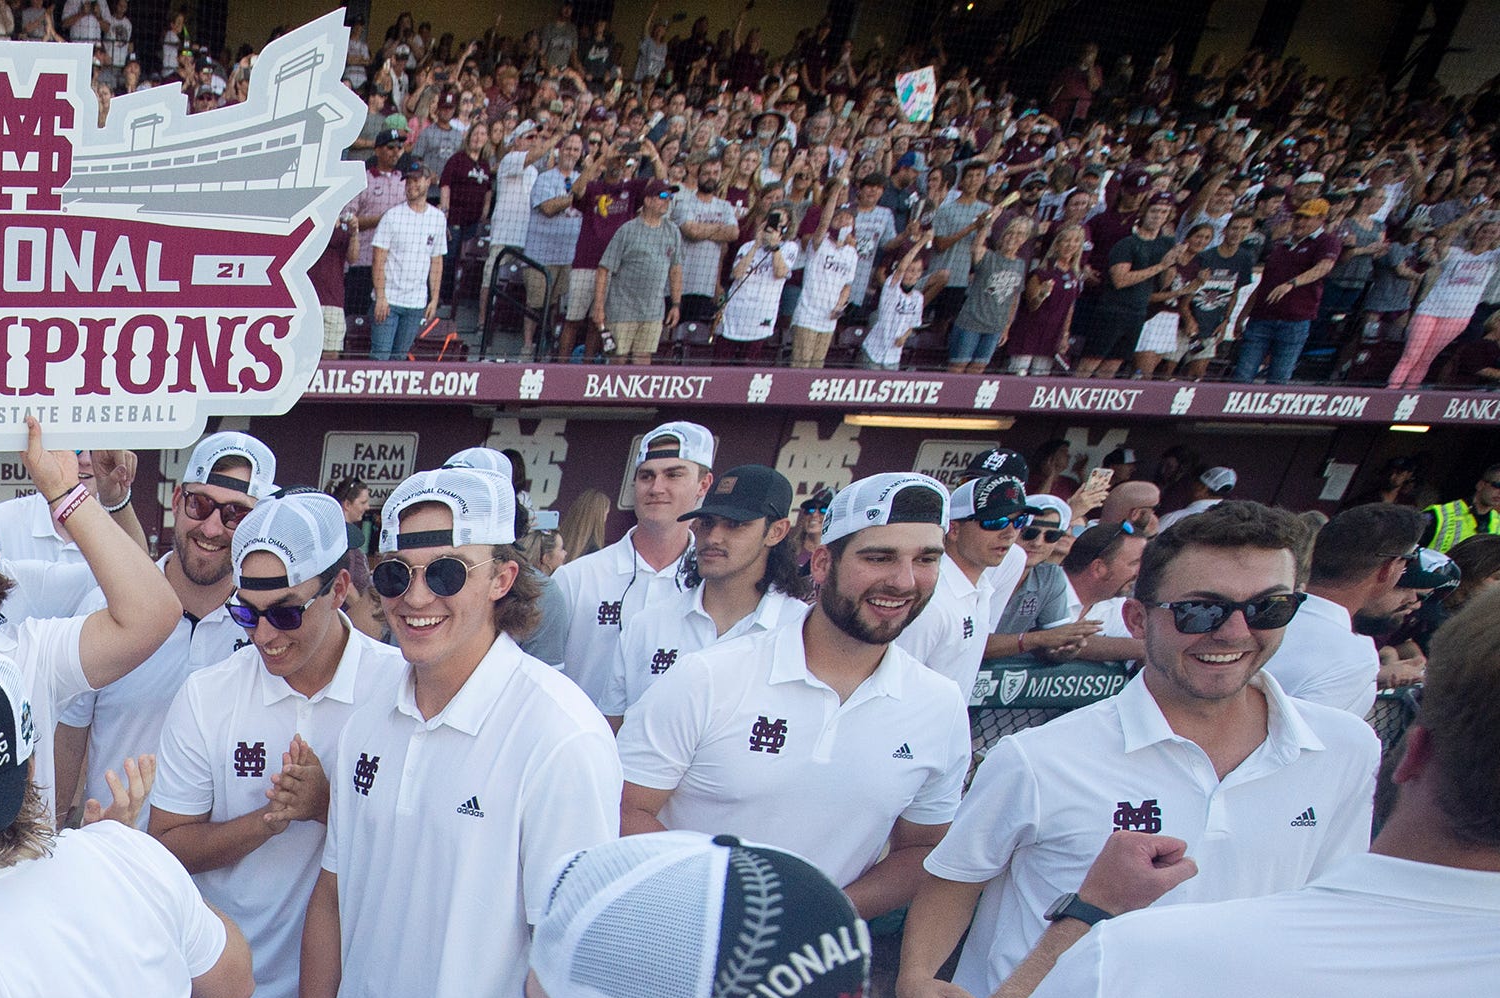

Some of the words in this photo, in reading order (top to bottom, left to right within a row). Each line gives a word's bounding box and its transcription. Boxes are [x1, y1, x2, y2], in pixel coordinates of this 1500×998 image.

[217, 262, 245, 278] 21
[304, 369, 480, 396] AILSTATE.COM
[583, 374, 712, 399] BANKFIRST
[808, 379, 943, 404] #HAILSTATE
[1030, 386, 1143, 411] BANKFIRST
[1222, 392, 1370, 418] HAILSTATE.COM
[71, 405, 178, 424] BASEBALL
[353, 444, 406, 462] FARM
[331, 463, 406, 482] BUREAU
[402, 488, 436, 504] NATIONAL
[437, 487, 469, 516] CHAMPIONS
[978, 476, 1011, 511] NATIONAL
[267, 537, 296, 564] CHAMPIONS
